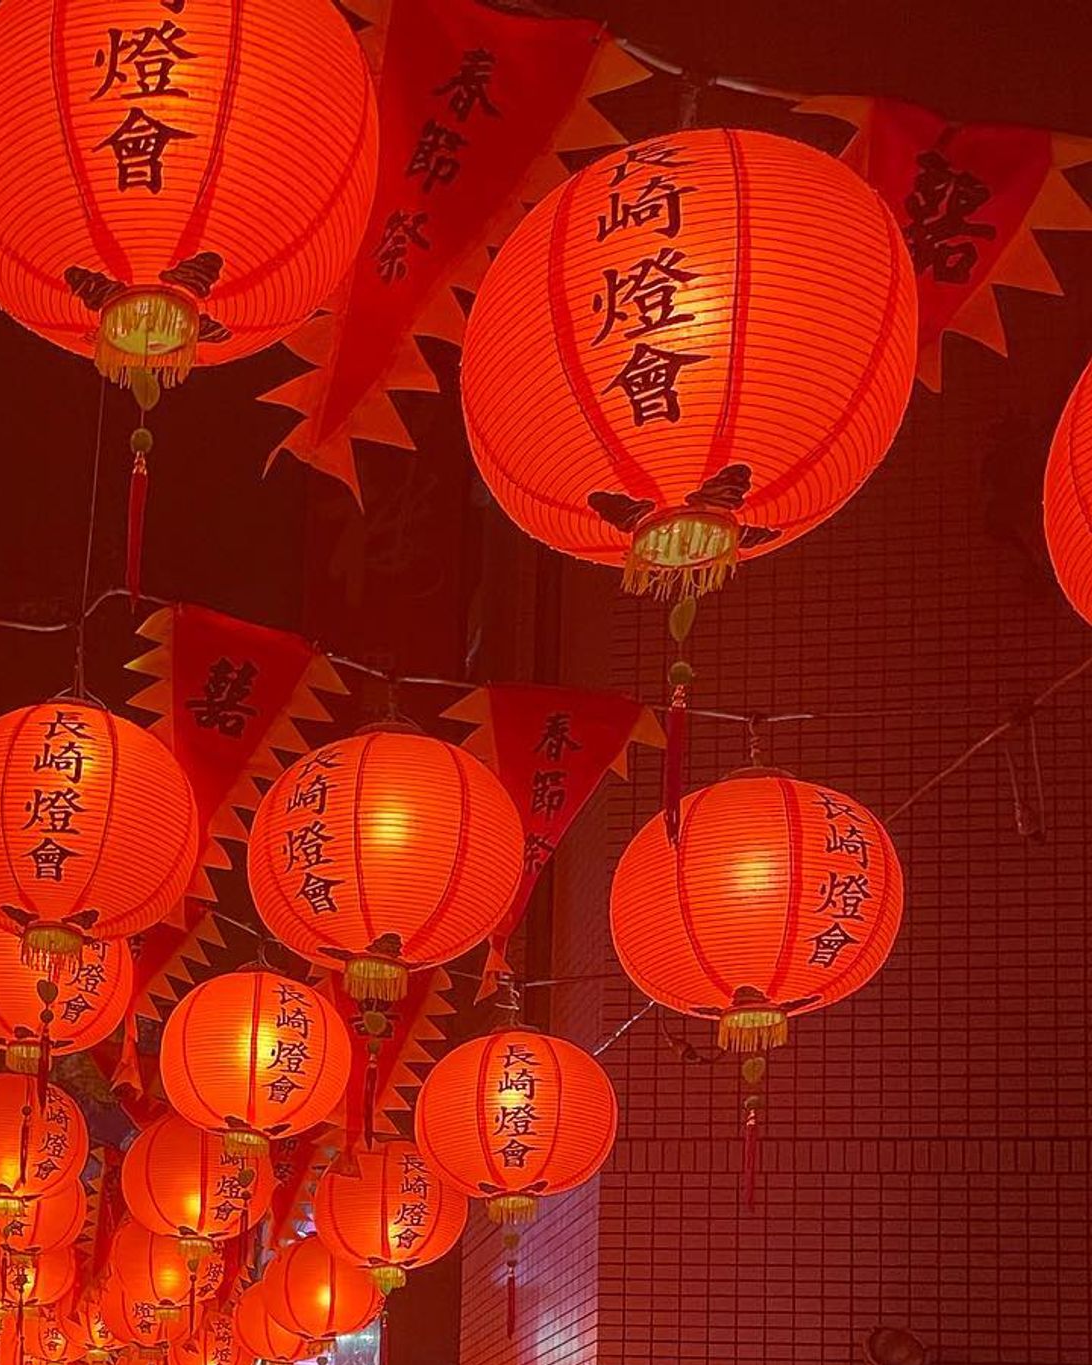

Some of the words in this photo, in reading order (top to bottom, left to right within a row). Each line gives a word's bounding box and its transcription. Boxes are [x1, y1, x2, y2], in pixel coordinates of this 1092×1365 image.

[89, 0, 200, 195] 燈會
[590, 141, 711, 428] 長崎燈會
[21, 711, 95, 883] 長崎燈會
[281, 750, 346, 915] 長崎燈會
[804, 789, 874, 969] 長崎燈會
[261, 982, 315, 1104] 長崎燈會
[492, 1044, 542, 1169] 長崎燈會
[390, 1152, 433, 1250] 長崎燈會
